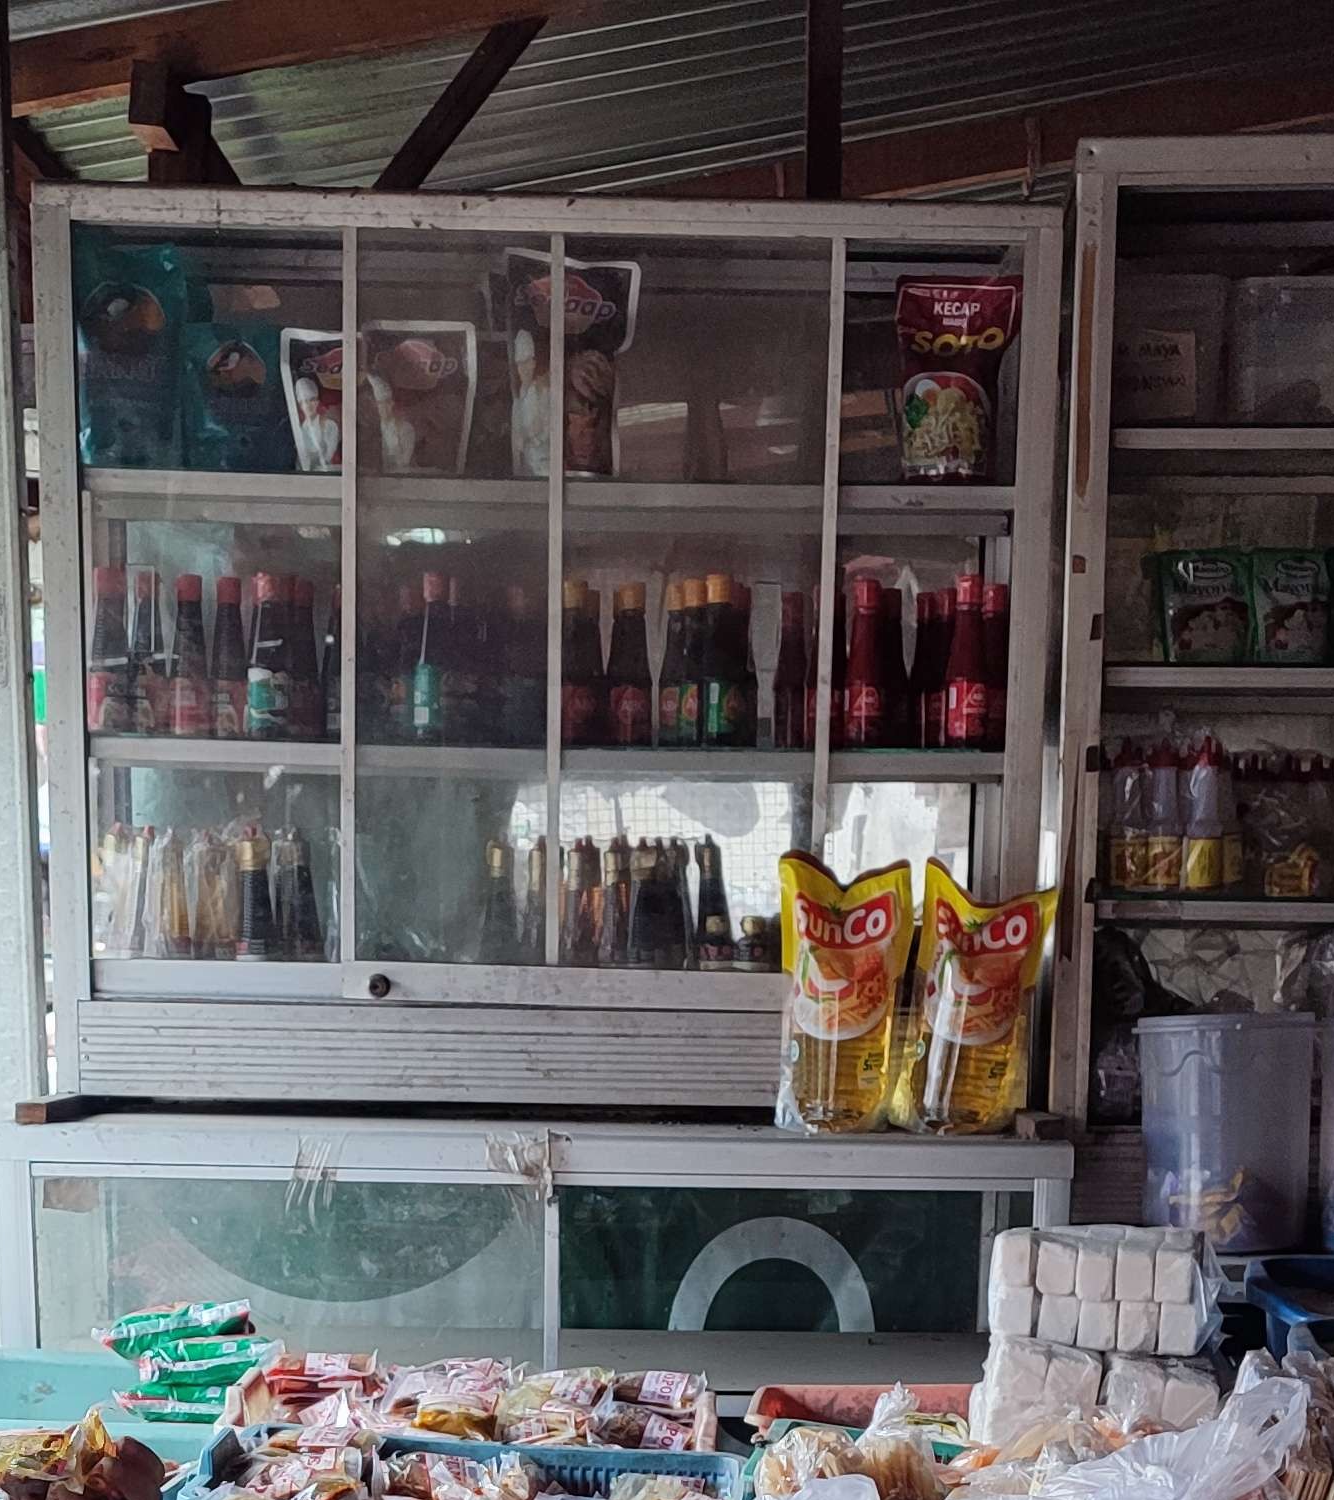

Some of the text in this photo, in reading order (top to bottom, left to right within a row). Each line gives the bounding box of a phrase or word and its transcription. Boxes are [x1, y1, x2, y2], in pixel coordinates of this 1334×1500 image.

[933, 301, 982, 319] KECAP
[910, 326, 1005, 358] SOTO
[796, 896, 887, 945] SunCo
